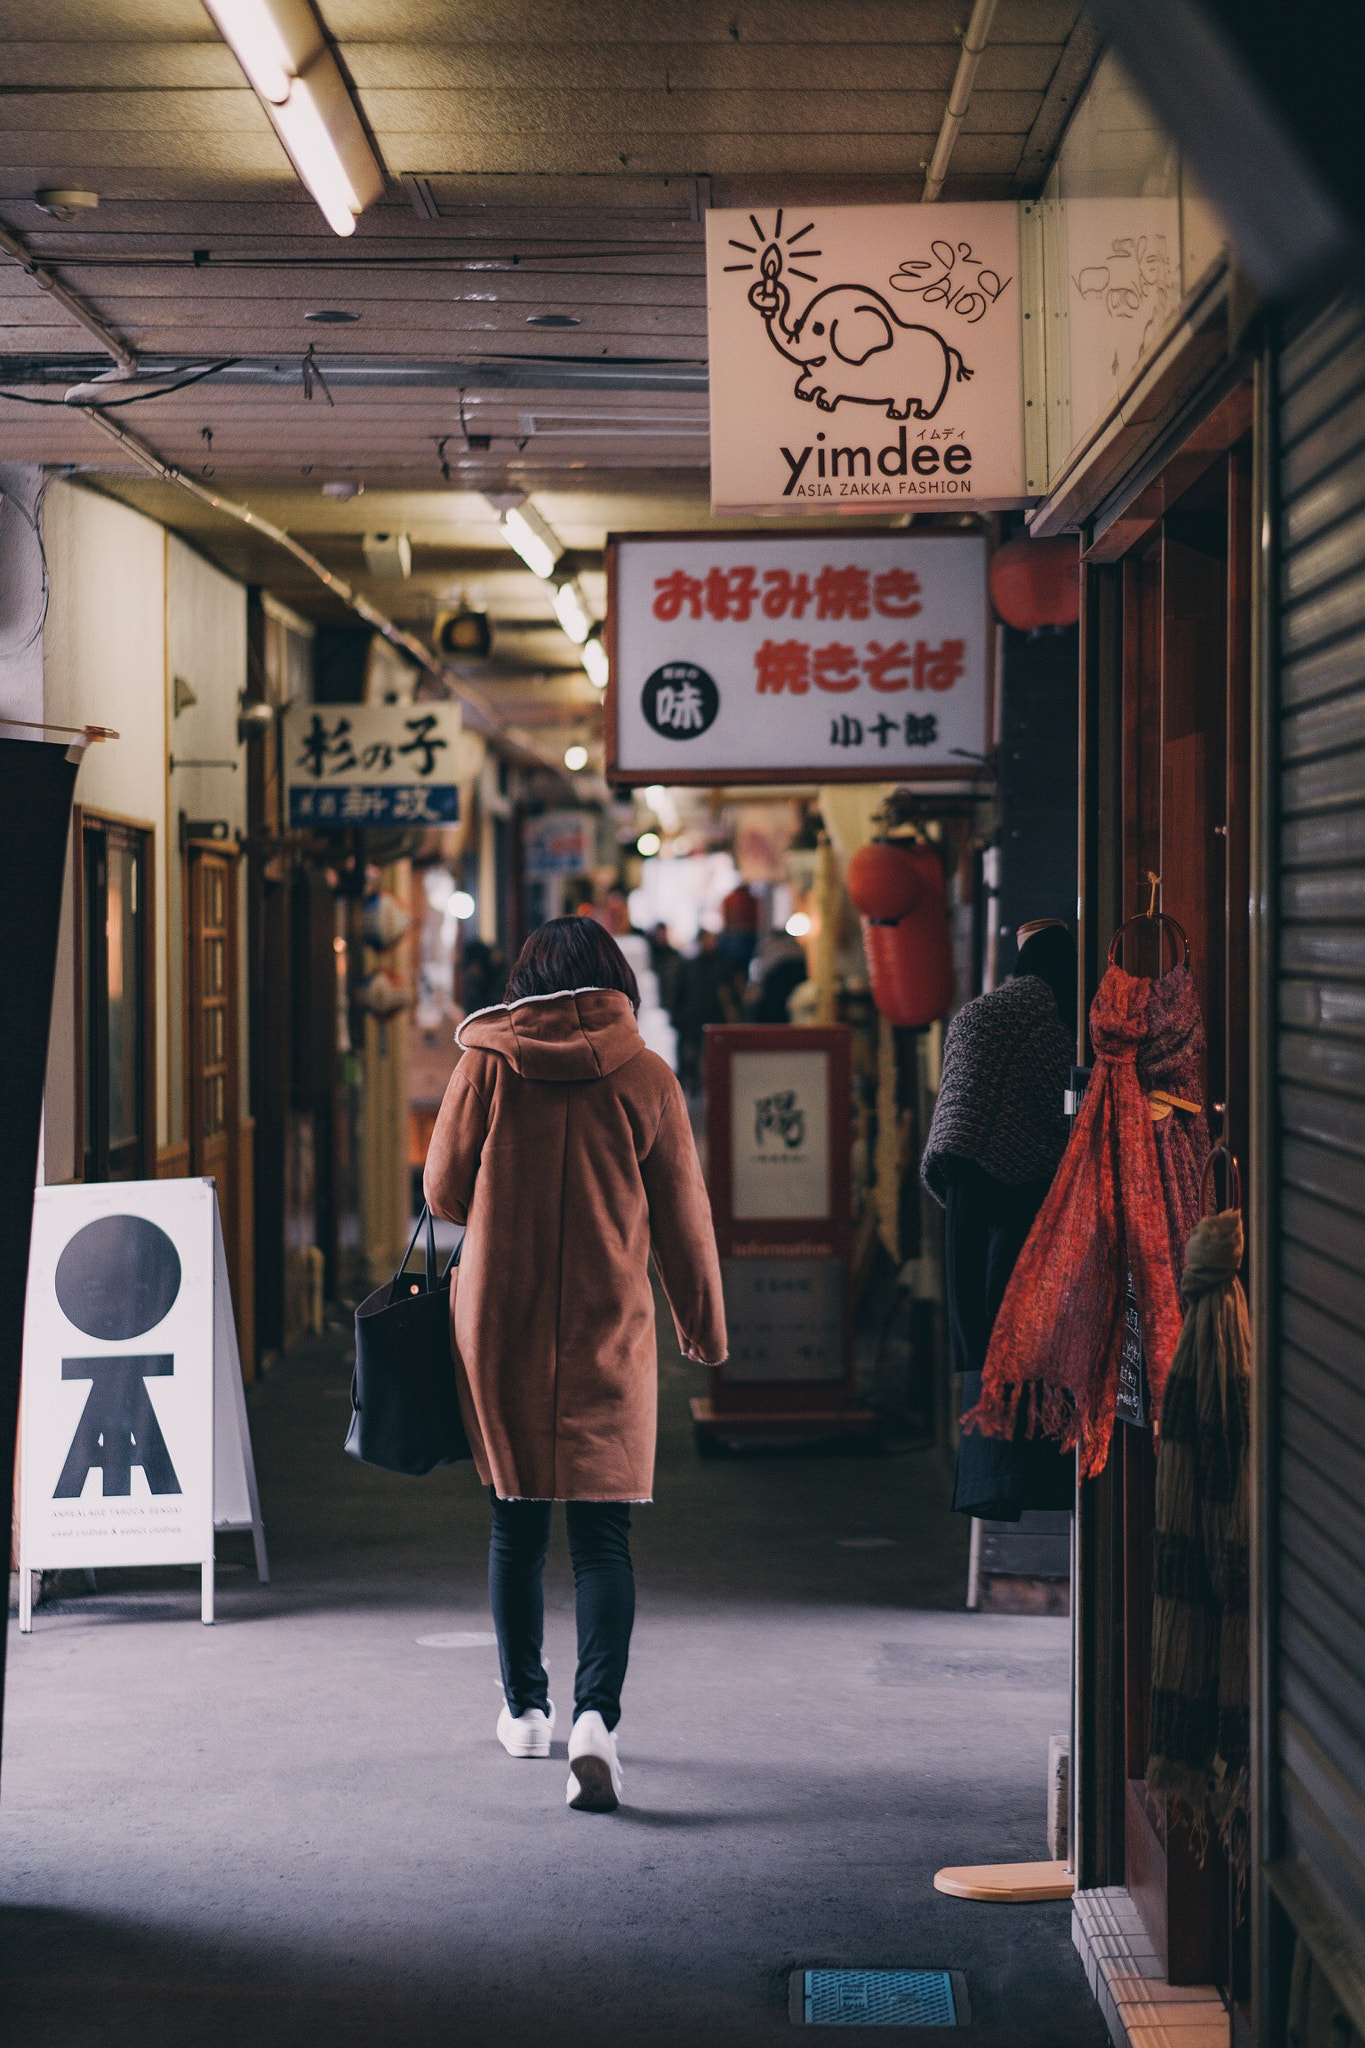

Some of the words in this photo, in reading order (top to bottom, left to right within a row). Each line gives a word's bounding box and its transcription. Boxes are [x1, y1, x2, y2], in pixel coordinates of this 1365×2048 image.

[779, 425, 973, 496] yimdee
[916, 427, 967, 441] イムディ
[797, 484, 832, 497] ASIA
[839, 482, 892, 496] ZAKKA
[898, 480, 972, 495] FASHION
[652, 565, 922, 622] お好み焼き
[754, 639, 965, 695] 焼きそば
[656, 681, 703, 730] 味
[297, 713, 448, 778] 杉の子
